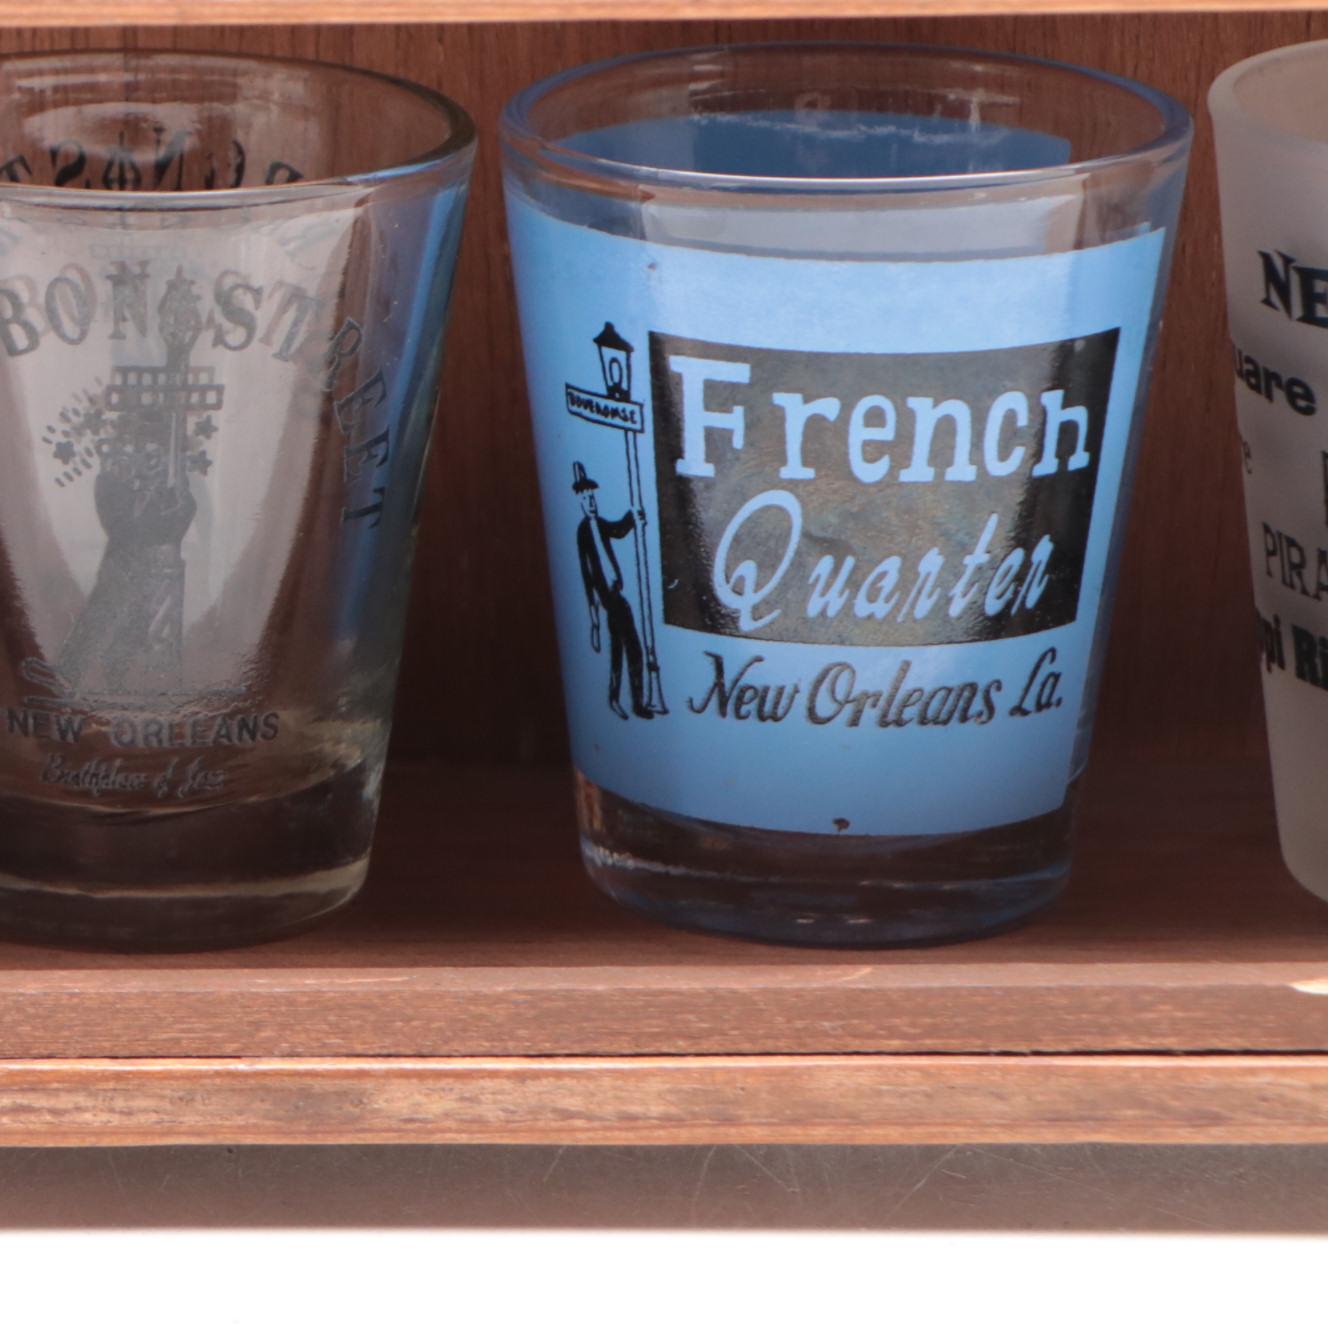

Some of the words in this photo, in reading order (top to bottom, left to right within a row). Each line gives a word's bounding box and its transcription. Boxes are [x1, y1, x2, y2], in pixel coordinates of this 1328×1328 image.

[210, 274, 390, 530] STREET
[667, 355, 1091, 483] French
[713, 490, 1055, 632] Quarter
[7, 706, 86, 744] NEW
[110, 711, 281, 749] ORLEANS
[687, 650, 800, 723] New
[806, 659, 1003, 728] Orleans
[1009, 646, 1063, 717] La.
